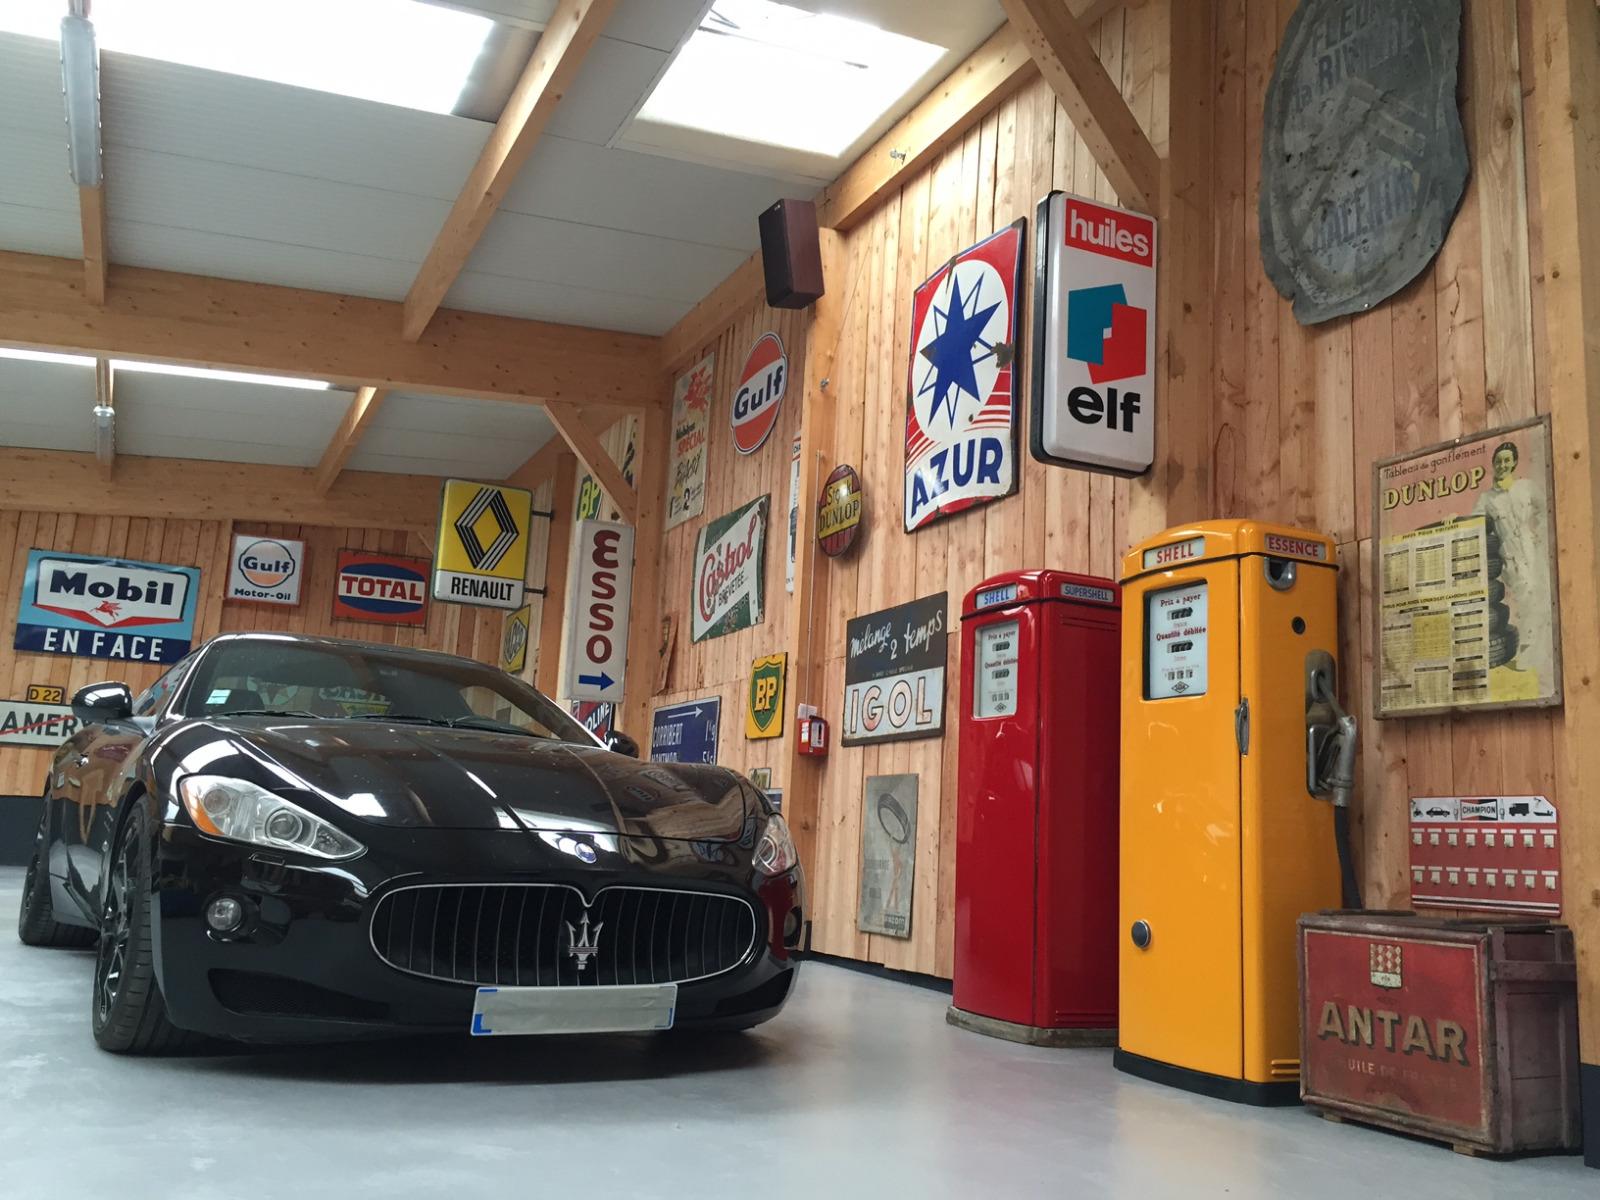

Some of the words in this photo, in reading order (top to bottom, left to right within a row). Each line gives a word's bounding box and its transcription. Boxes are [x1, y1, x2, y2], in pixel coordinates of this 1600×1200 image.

[1070, 208, 1149, 257] huiles
[734, 367, 785, 420] Gulf
[1067, 386, 1141, 433] elf
[911, 437, 1004, 518] AZUR
[1384, 463, 1418, 480] Tableau
[1430, 444, 1486, 474] gonflement
[1384, 465, 1486, 510] DUNLOP
[819, 499, 860, 531] DUNLOP
[1156, 546, 1194, 564] SHELL
[1268, 539, 1319, 558] ESSENCE
[243, 557, 290, 575] Gulf
[700, 514, 757, 622] Castrol
[49, 570, 175, 605] Mobil
[234, 587, 292, 601] Motor-Oil
[341, 576, 423, 602] TOTAL
[451, 576, 515, 602] RENAULT
[984, 589, 1011, 604] SHELL
[1064, 585, 1109, 601] SUPERSHELL
[1182, 593, 1202, 605] payer
[43, 627, 79, 654] EN
[91, 632, 163, 661] FACE
[850, 622, 892, 659] mélange
[890, 639, 898, 660] 2
[904, 610, 943, 655] temps
[30, 688, 39, 700] D
[42, 690, 61, 702] 22
[754, 676, 778, 715] BP
[850, 676, 933, 734] IGOL
[0, 711, 92, 737] AMER
[1462, 804, 1497, 815] CHAMPION
[1318, 1000, 1468, 1065] ANTAR
